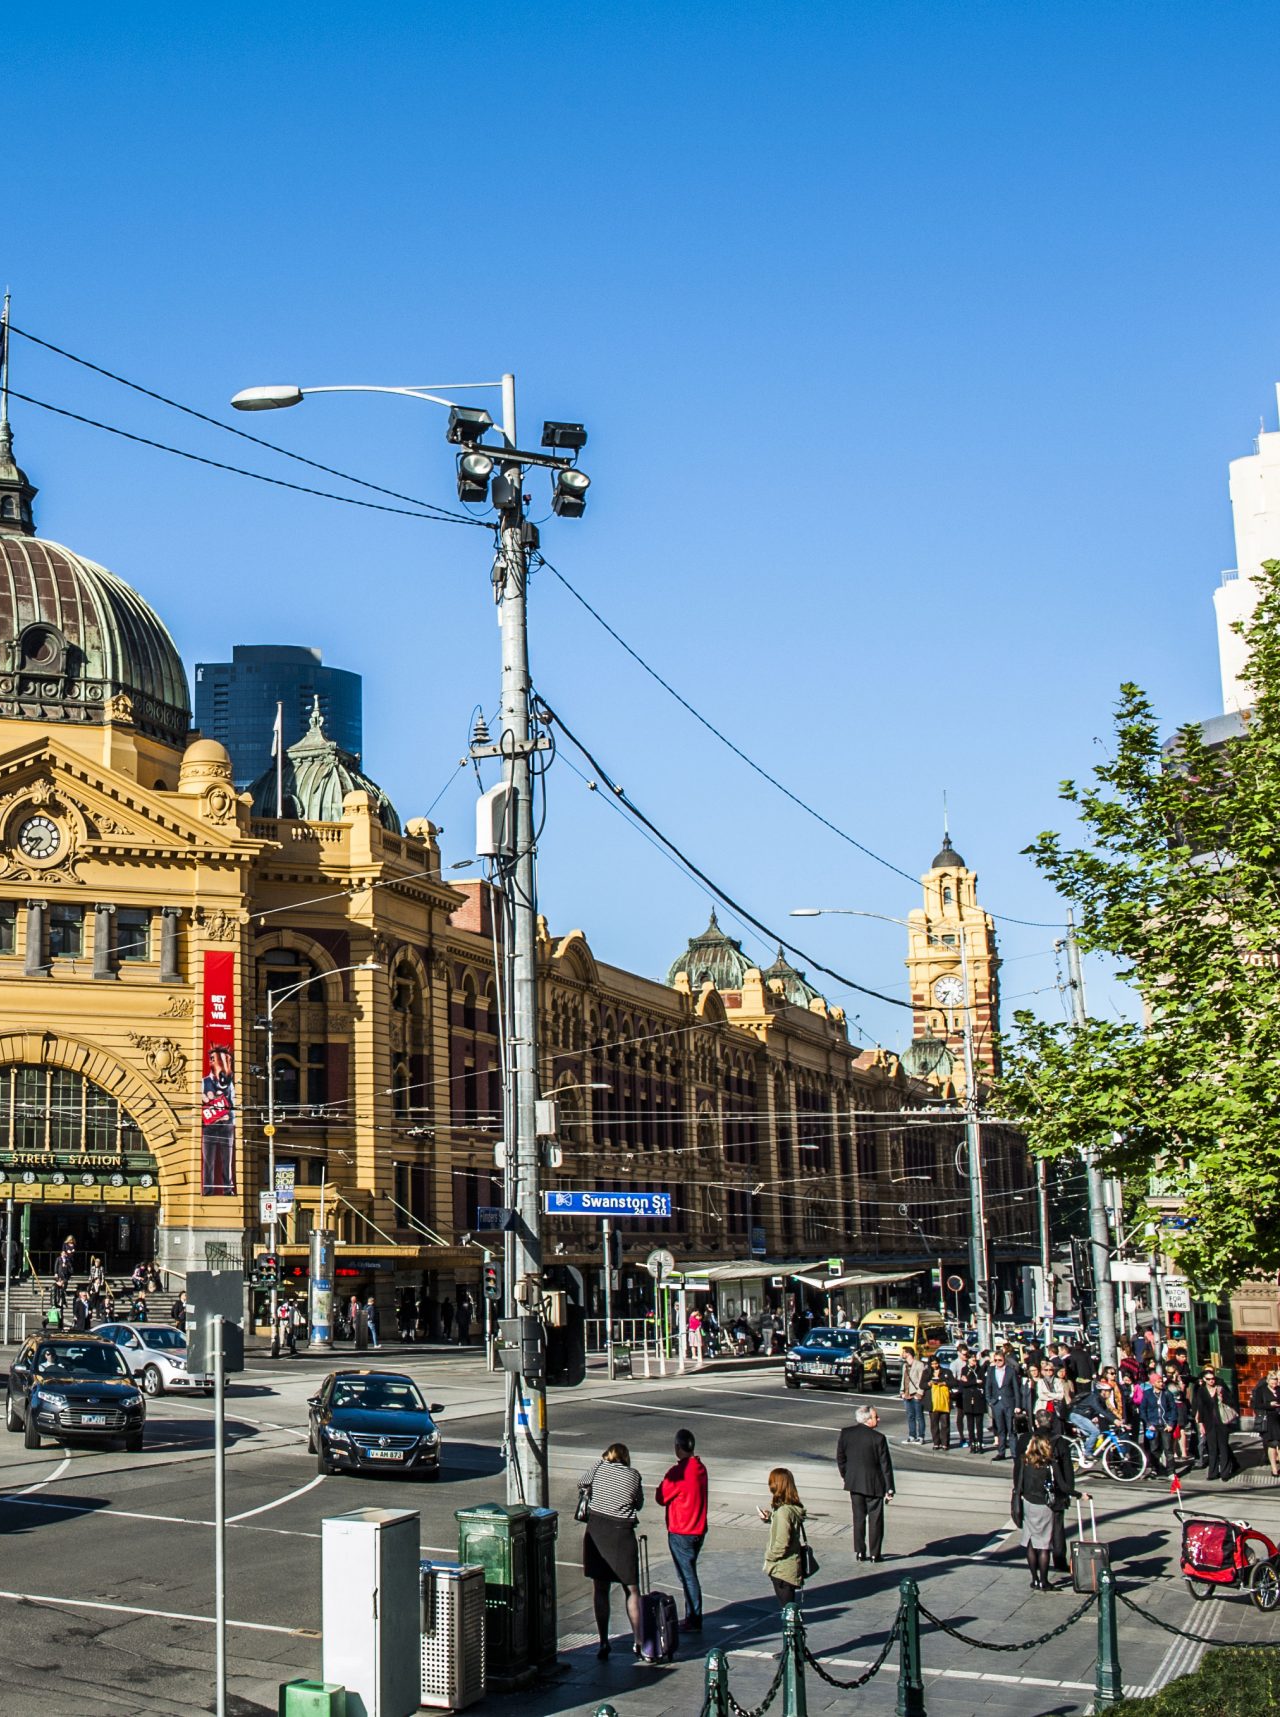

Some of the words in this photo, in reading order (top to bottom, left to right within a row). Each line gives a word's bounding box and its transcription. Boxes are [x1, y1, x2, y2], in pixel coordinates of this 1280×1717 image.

[211, 994, 227, 1003] BET
[213, 1003, 224, 1011] TO
[210, 1011, 227, 1020] WIN
[12, 1153, 55, 1165] STREET
[69, 1154, 122, 1166] STATION
[582, 1194, 649, 1209] Swanston
[652, 1194, 667, 1209] St
